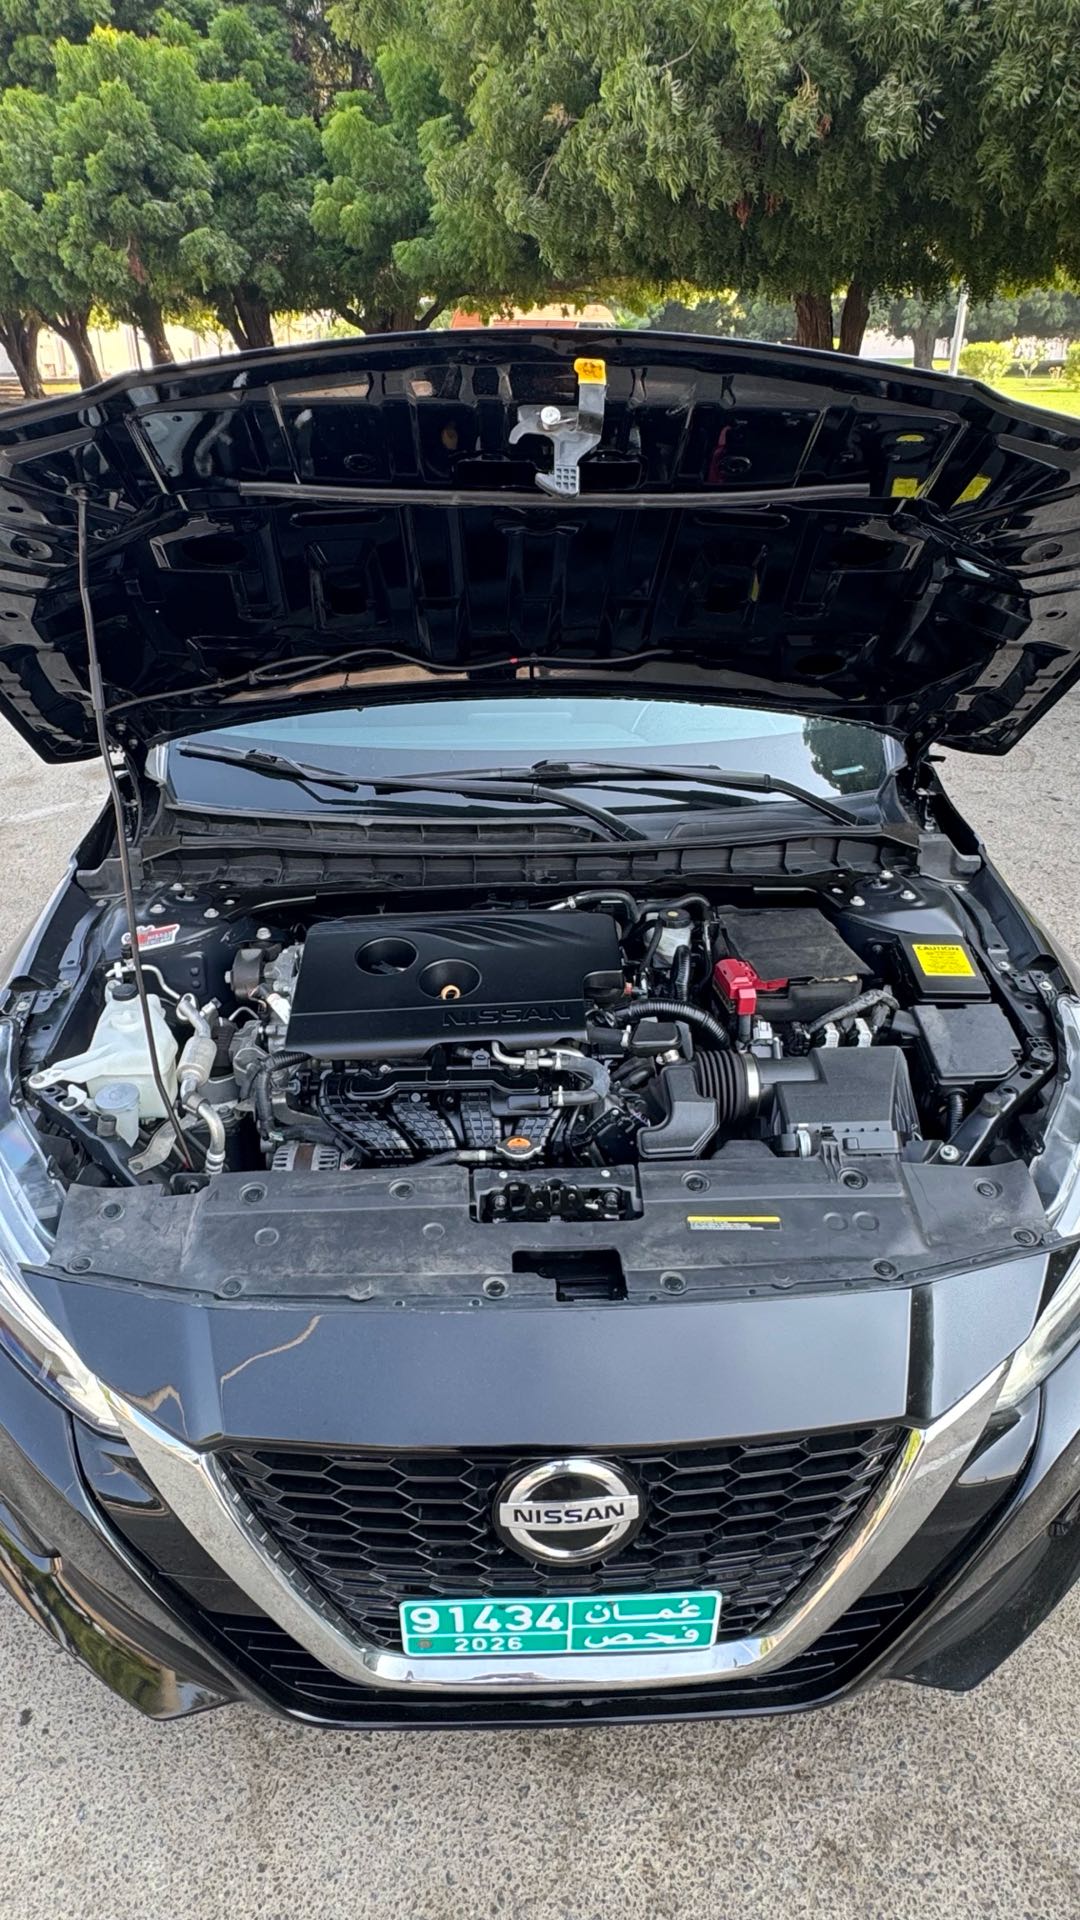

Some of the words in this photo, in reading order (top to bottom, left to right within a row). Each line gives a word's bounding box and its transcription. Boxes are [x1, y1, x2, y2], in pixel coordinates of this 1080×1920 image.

[442, 1005, 571, 1026] NISSAN
[513, 1502, 625, 1524] NISSAN
[410, 1604, 564, 1633] 91434
[454, 1636, 523, 1652] 2026
[584, 1625, 700, 1648] فحص
